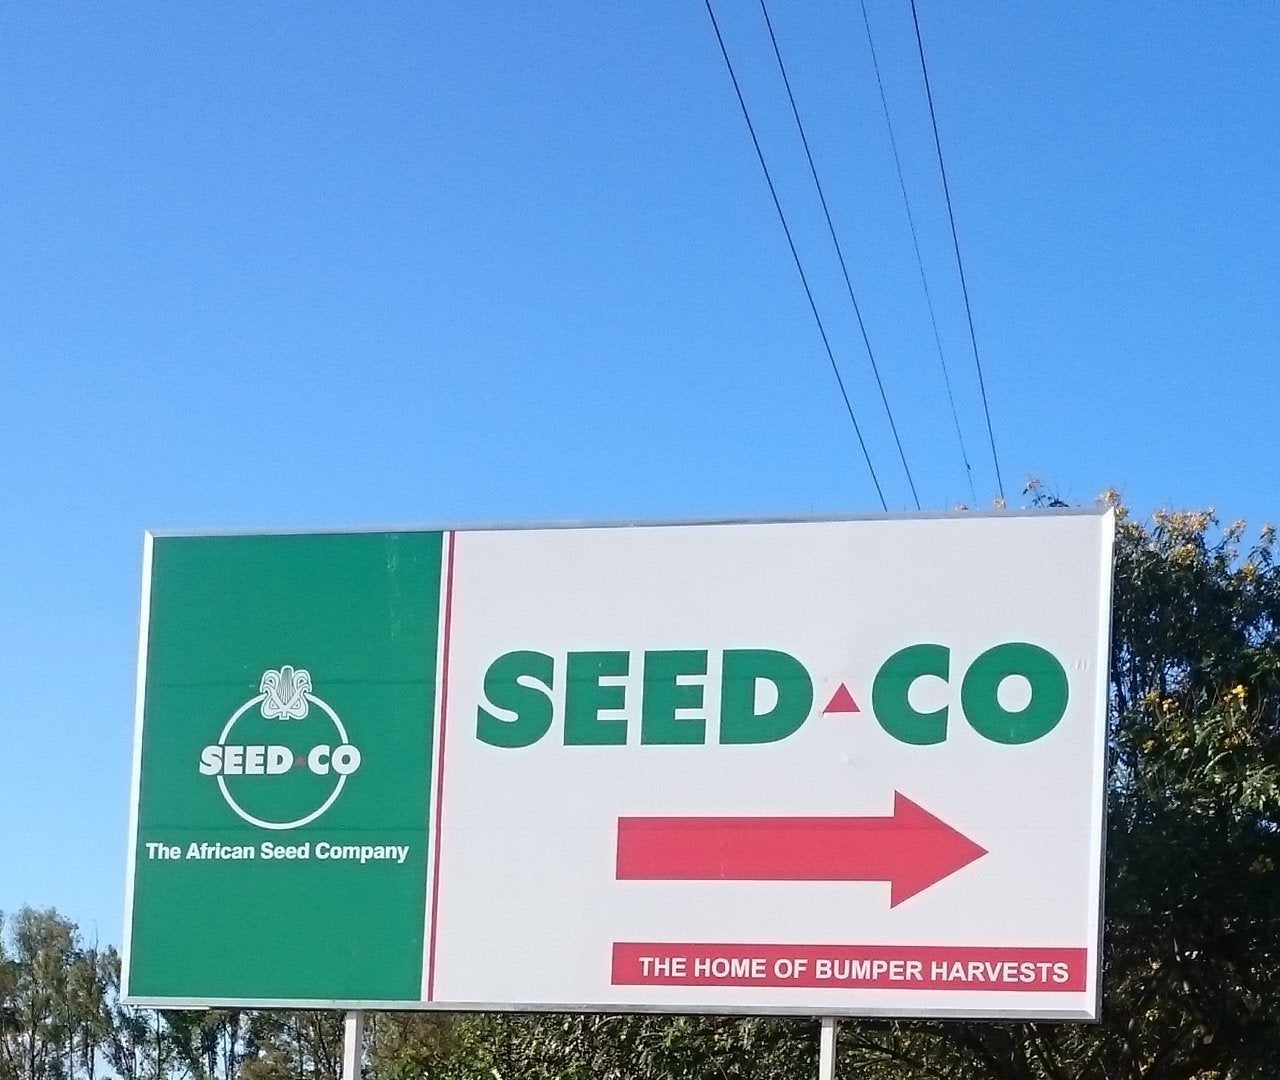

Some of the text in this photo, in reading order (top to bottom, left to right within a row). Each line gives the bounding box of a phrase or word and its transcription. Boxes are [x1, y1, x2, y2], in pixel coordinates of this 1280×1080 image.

[477, 641, 1069, 748] SEED CO
[199, 744, 362, 776] SEED CO
[146, 841, 410, 864] The African Seed Company
[638, 956, 1070, 984] THE HOME OF BUMPER HARVESTS
